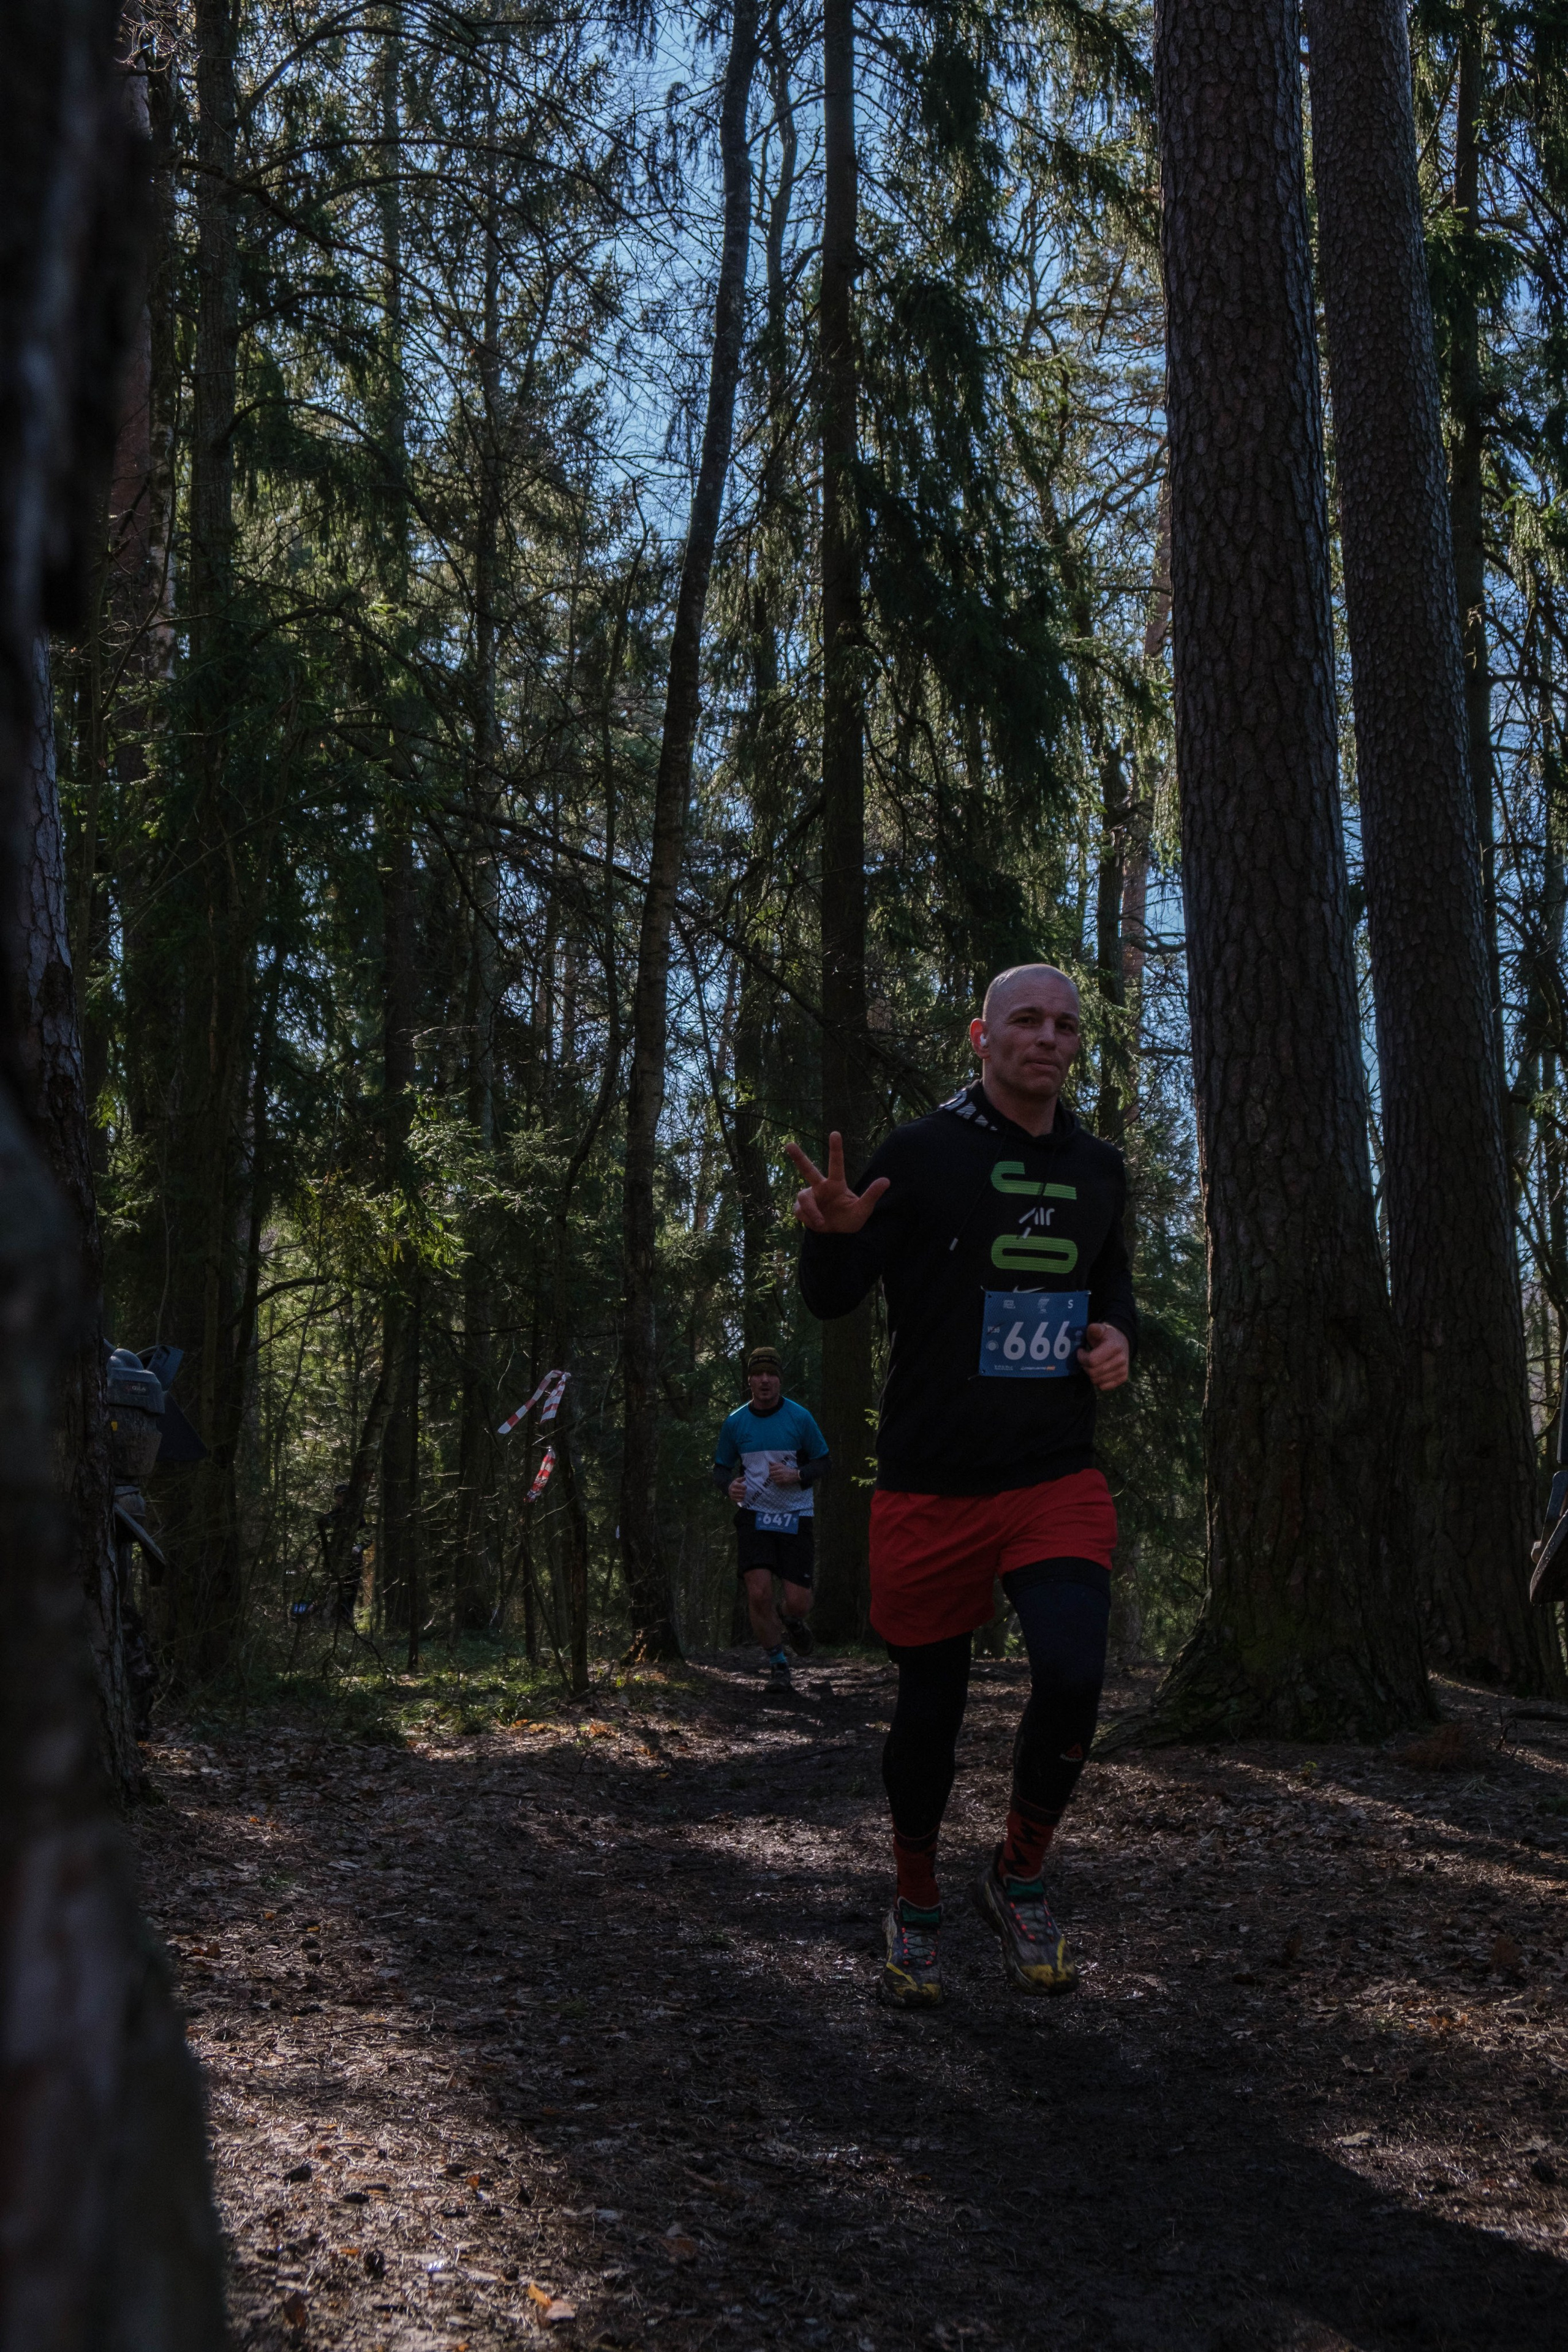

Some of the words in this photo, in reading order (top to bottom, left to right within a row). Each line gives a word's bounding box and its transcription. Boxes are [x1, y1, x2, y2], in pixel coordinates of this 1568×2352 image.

[1068, 1299, 1074, 1309] S
[1004, 1321, 1071, 1360] 666
[763, 1513, 791, 1527] 647
